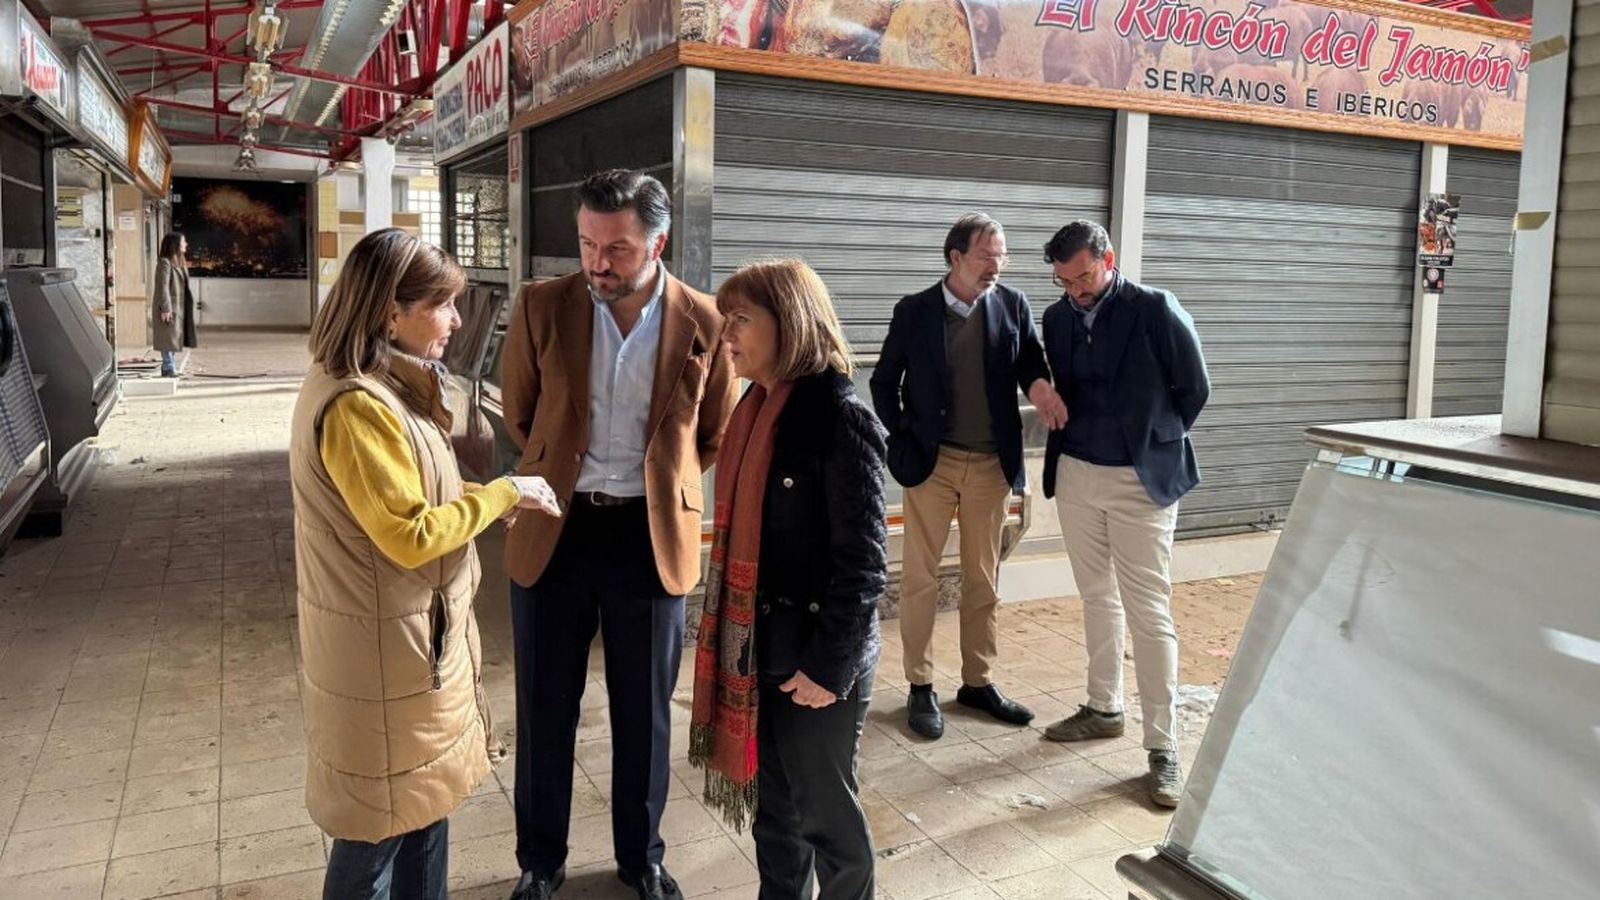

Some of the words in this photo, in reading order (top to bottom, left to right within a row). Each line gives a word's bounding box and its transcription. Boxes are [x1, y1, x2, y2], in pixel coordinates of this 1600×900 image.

[1115, 0, 1289, 58] Rincón
[1301, 12, 1379, 71] del
[466, 38, 503, 119] PACO
[1144, 67, 1287, 104] SERRANOS
[1306, 88, 1319, 108] E
[1336, 91, 1438, 122] IBÉRICOS
